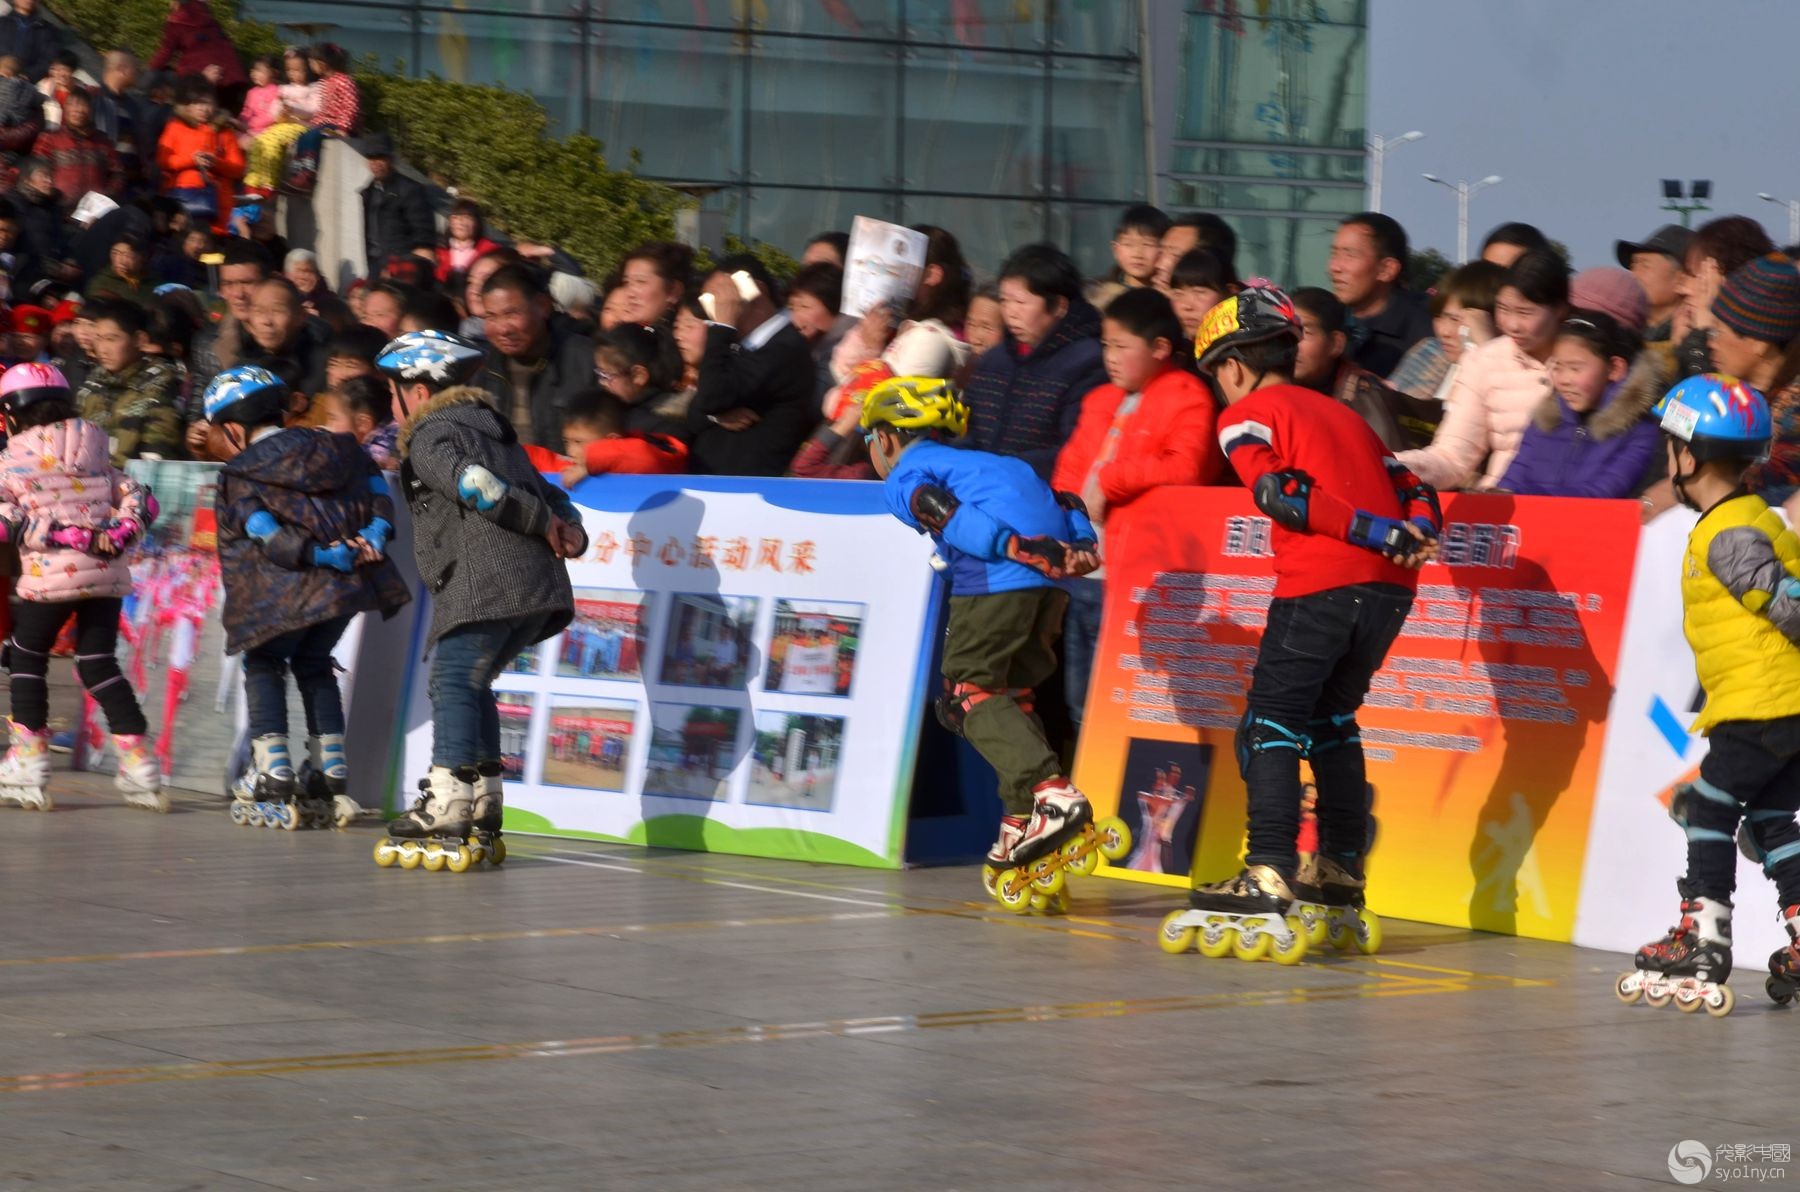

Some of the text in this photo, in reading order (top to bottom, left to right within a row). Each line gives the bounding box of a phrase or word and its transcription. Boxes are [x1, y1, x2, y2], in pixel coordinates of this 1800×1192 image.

[570, 530, 817, 575] 分中心活动风采
